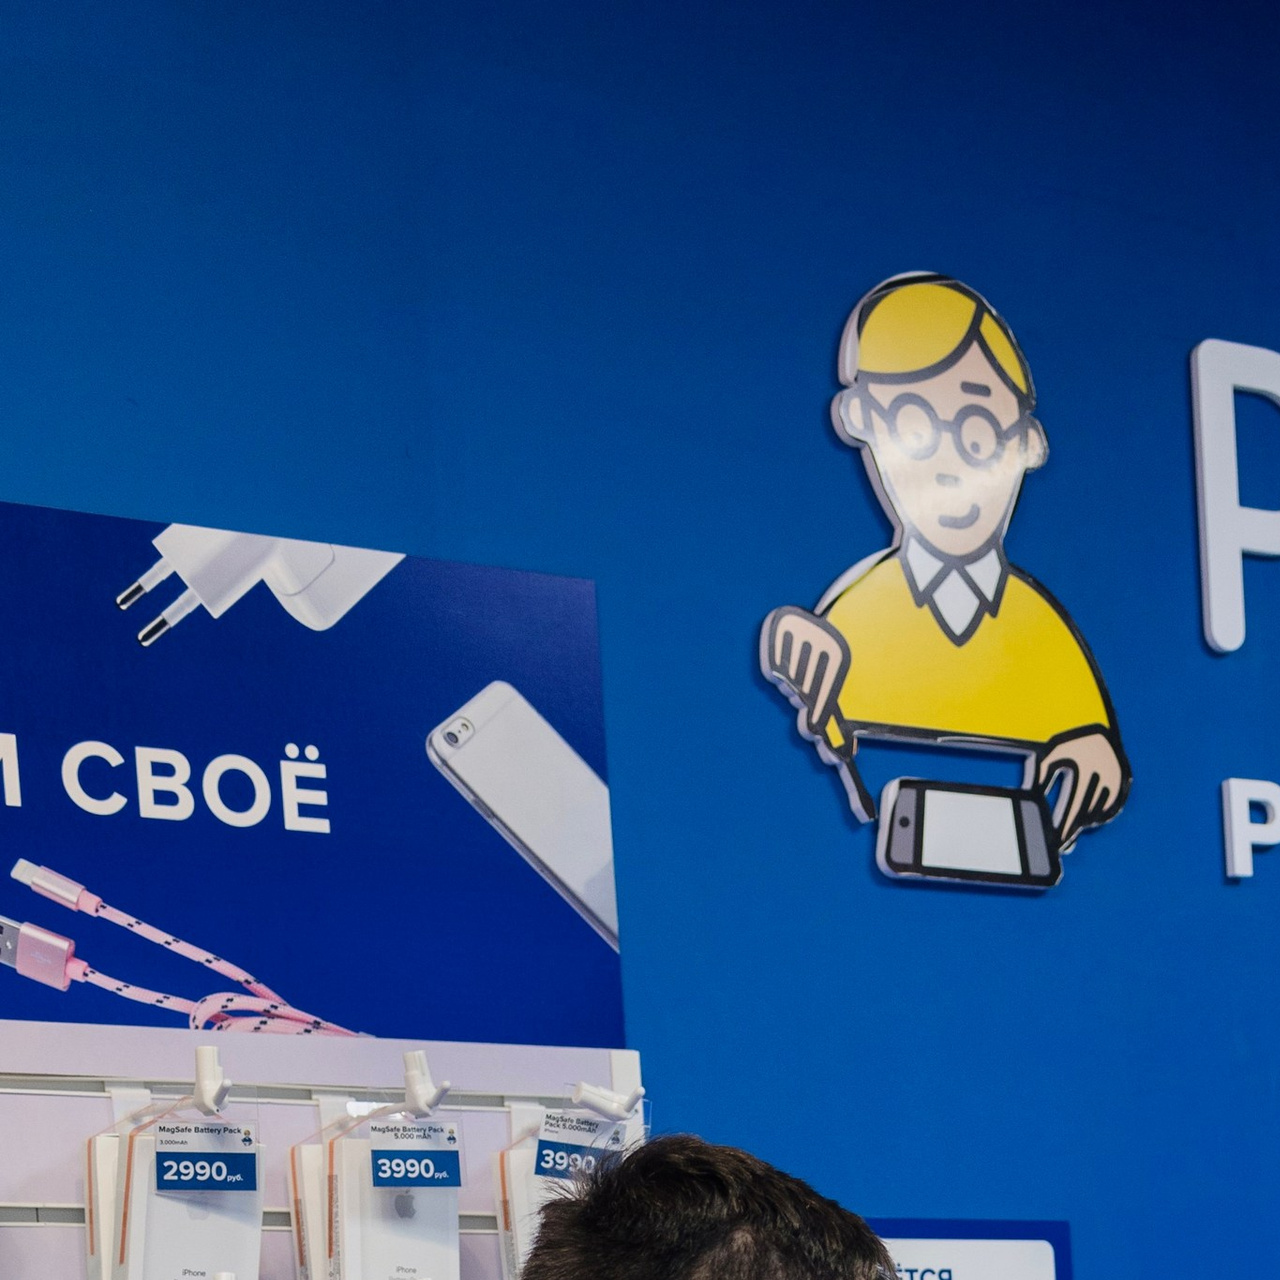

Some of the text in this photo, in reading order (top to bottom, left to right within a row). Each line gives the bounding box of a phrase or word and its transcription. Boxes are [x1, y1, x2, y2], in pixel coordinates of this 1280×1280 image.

[61, 741, 331, 833] СВОЁ
[545, 1114, 574, 1124] MagSafe
[158, 1126, 192, 1134] MagSafe
[194, 1126, 222, 1135] Battery
[371, 1126, 400, 1134] MagSafe
[402, 1126, 427, 1135] Battery
[163, 1160, 243, 1182] 2990 руб.
[377, 1158, 449, 1179] 3990 руб.
[540, 1149, 596, 1174] 3990
